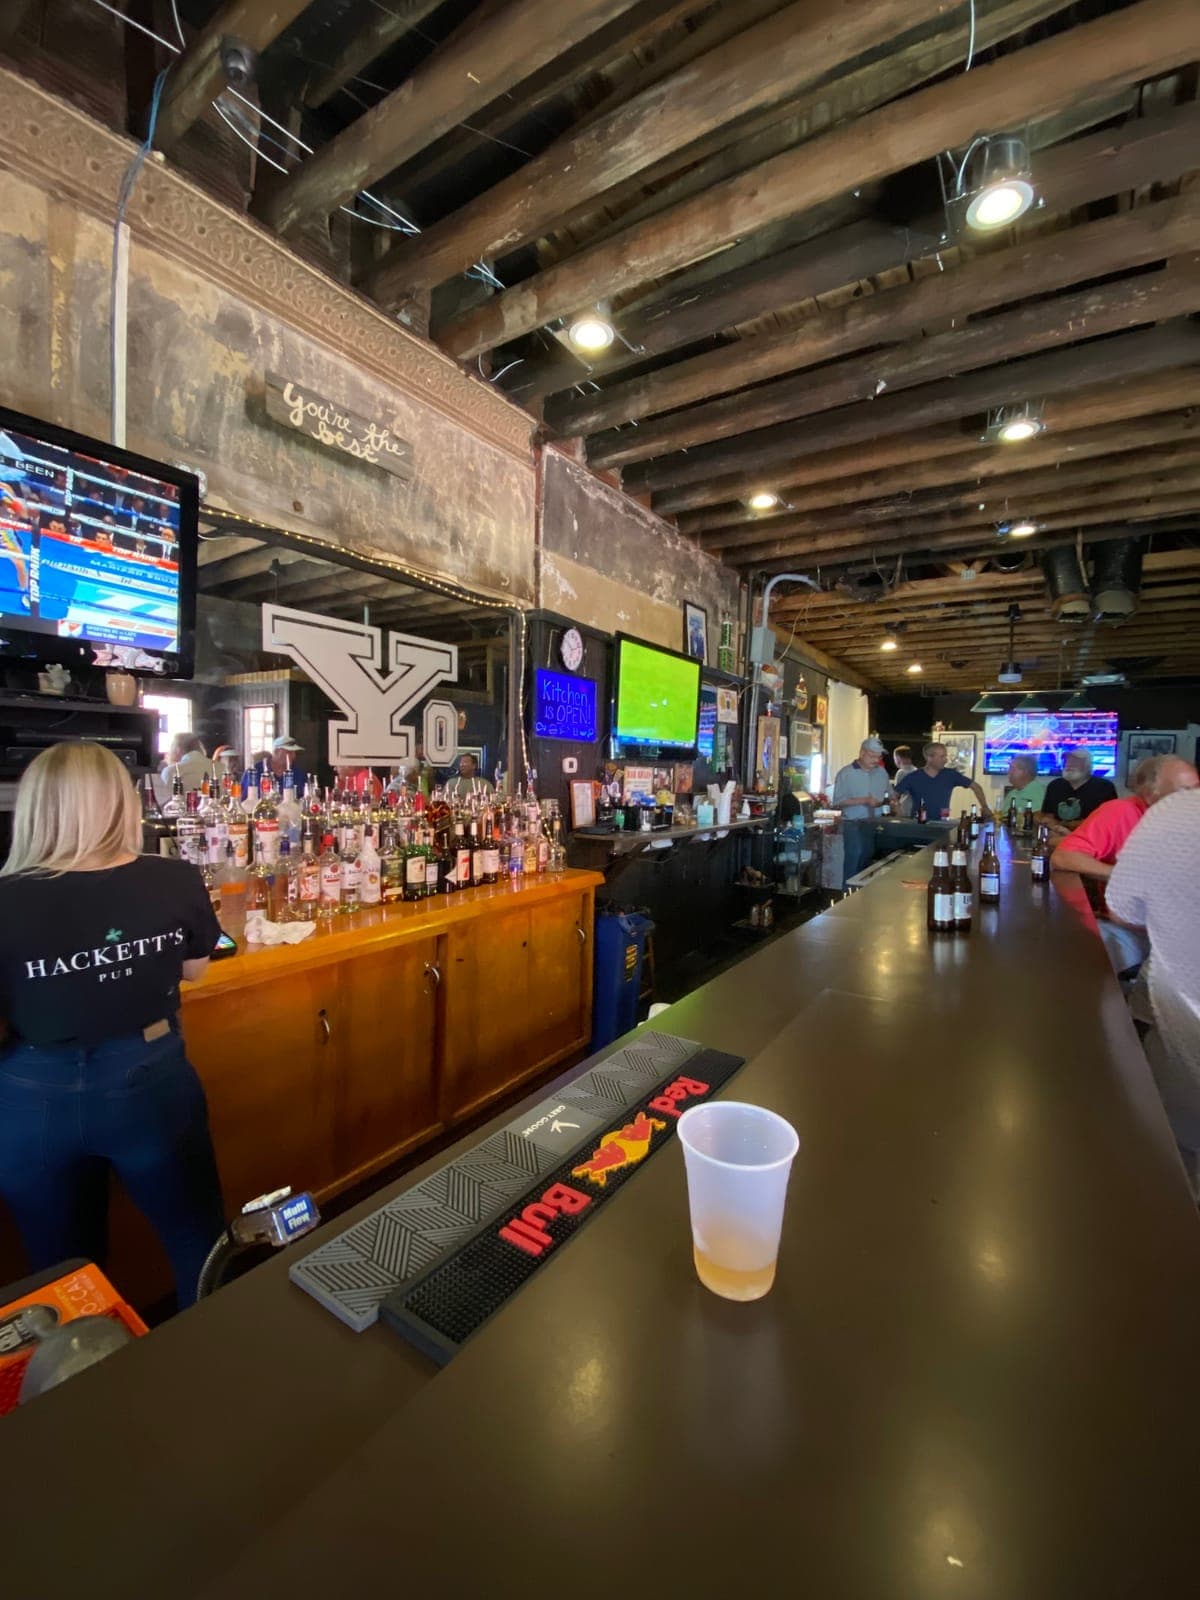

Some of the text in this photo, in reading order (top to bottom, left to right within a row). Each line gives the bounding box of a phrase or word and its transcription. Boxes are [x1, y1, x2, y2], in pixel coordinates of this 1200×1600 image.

[311, 421, 379, 463] best
[361, 423, 405, 455] the
[15, 460, 55, 479] BEEN
[30, 578, 40, 602] TOP
[542, 679, 588, 707] Kitchen
[25, 927, 184, 979] HACKETT'S
[99, 967, 133, 983] PUB
[499, 1075, 710, 1257] Red Bull
[283, 1199, 307, 1220] Multi
